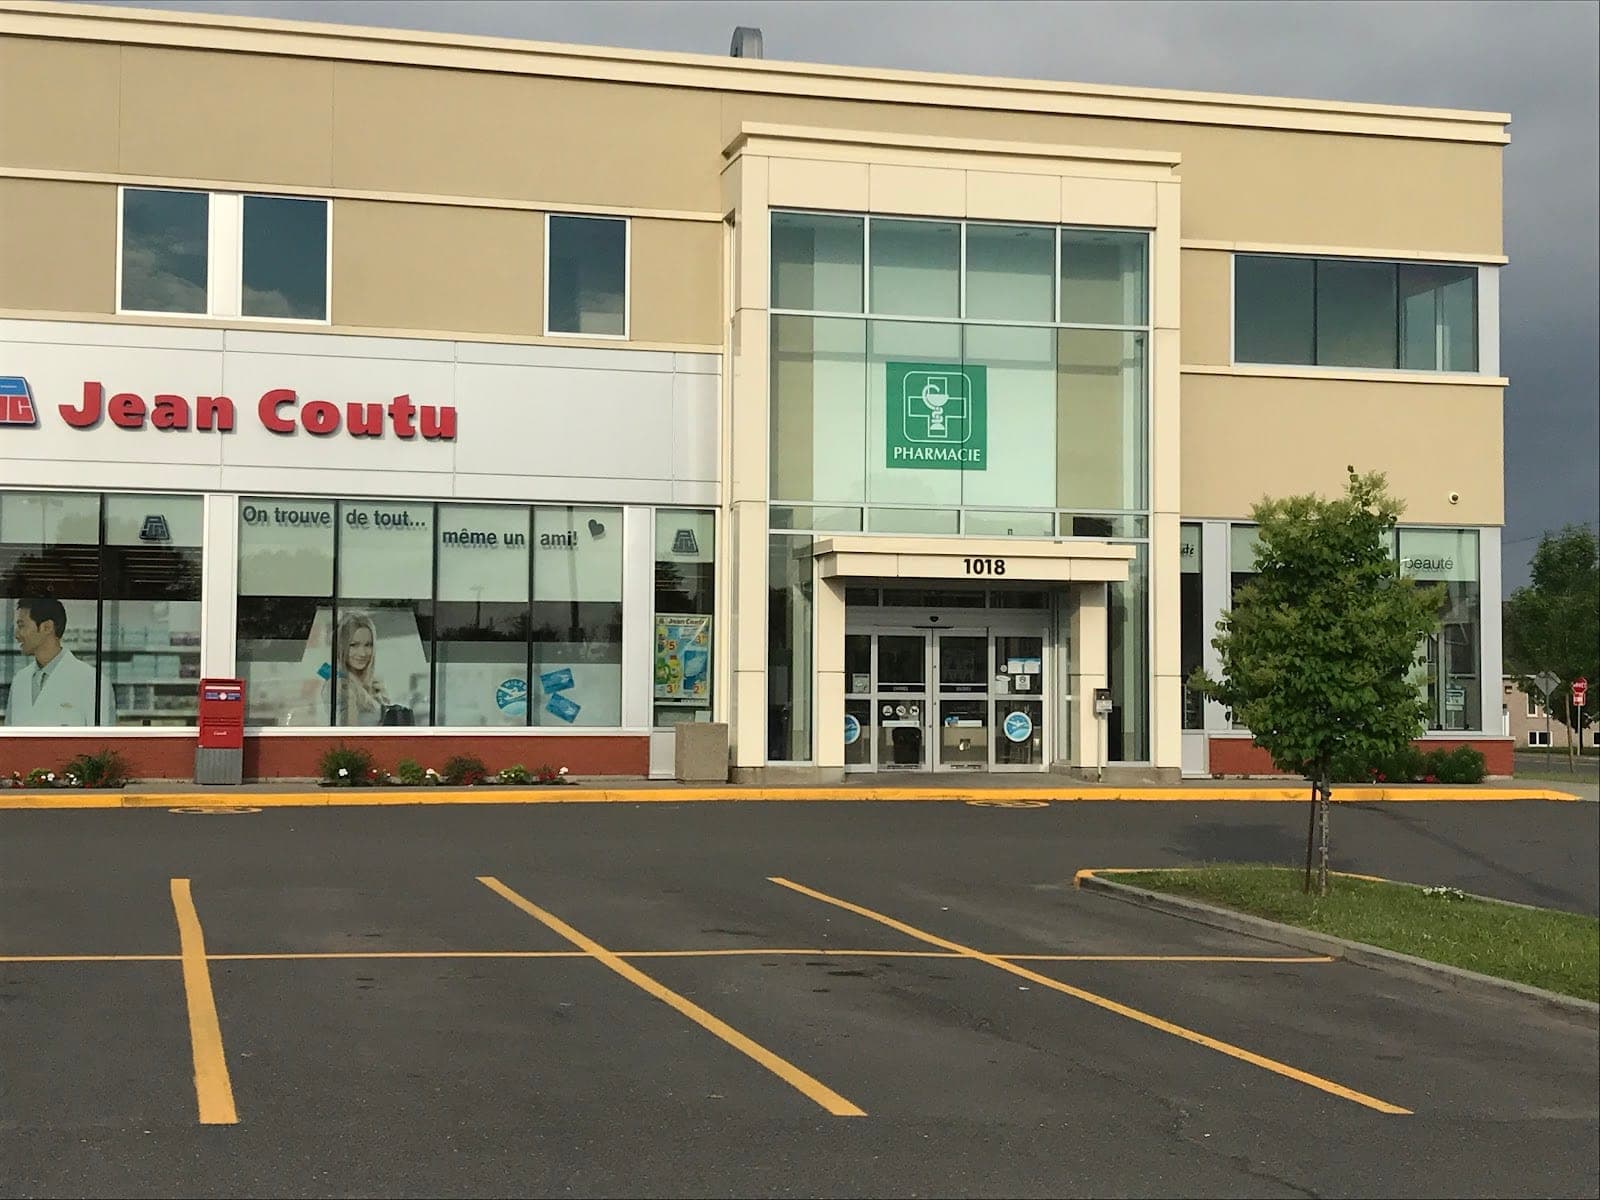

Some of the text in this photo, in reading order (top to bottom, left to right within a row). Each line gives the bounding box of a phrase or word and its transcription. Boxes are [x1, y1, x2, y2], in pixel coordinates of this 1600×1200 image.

[58, 381, 457, 439] Jean Coutu
[893, 446, 981, 462] PHARMACIE
[242, 505, 426, 526] On trouve de tout...
[442, 528, 578, 546] même un ami!
[963, 558, 1006, 575] 1018
[1404, 556, 1455, 570] beauté
